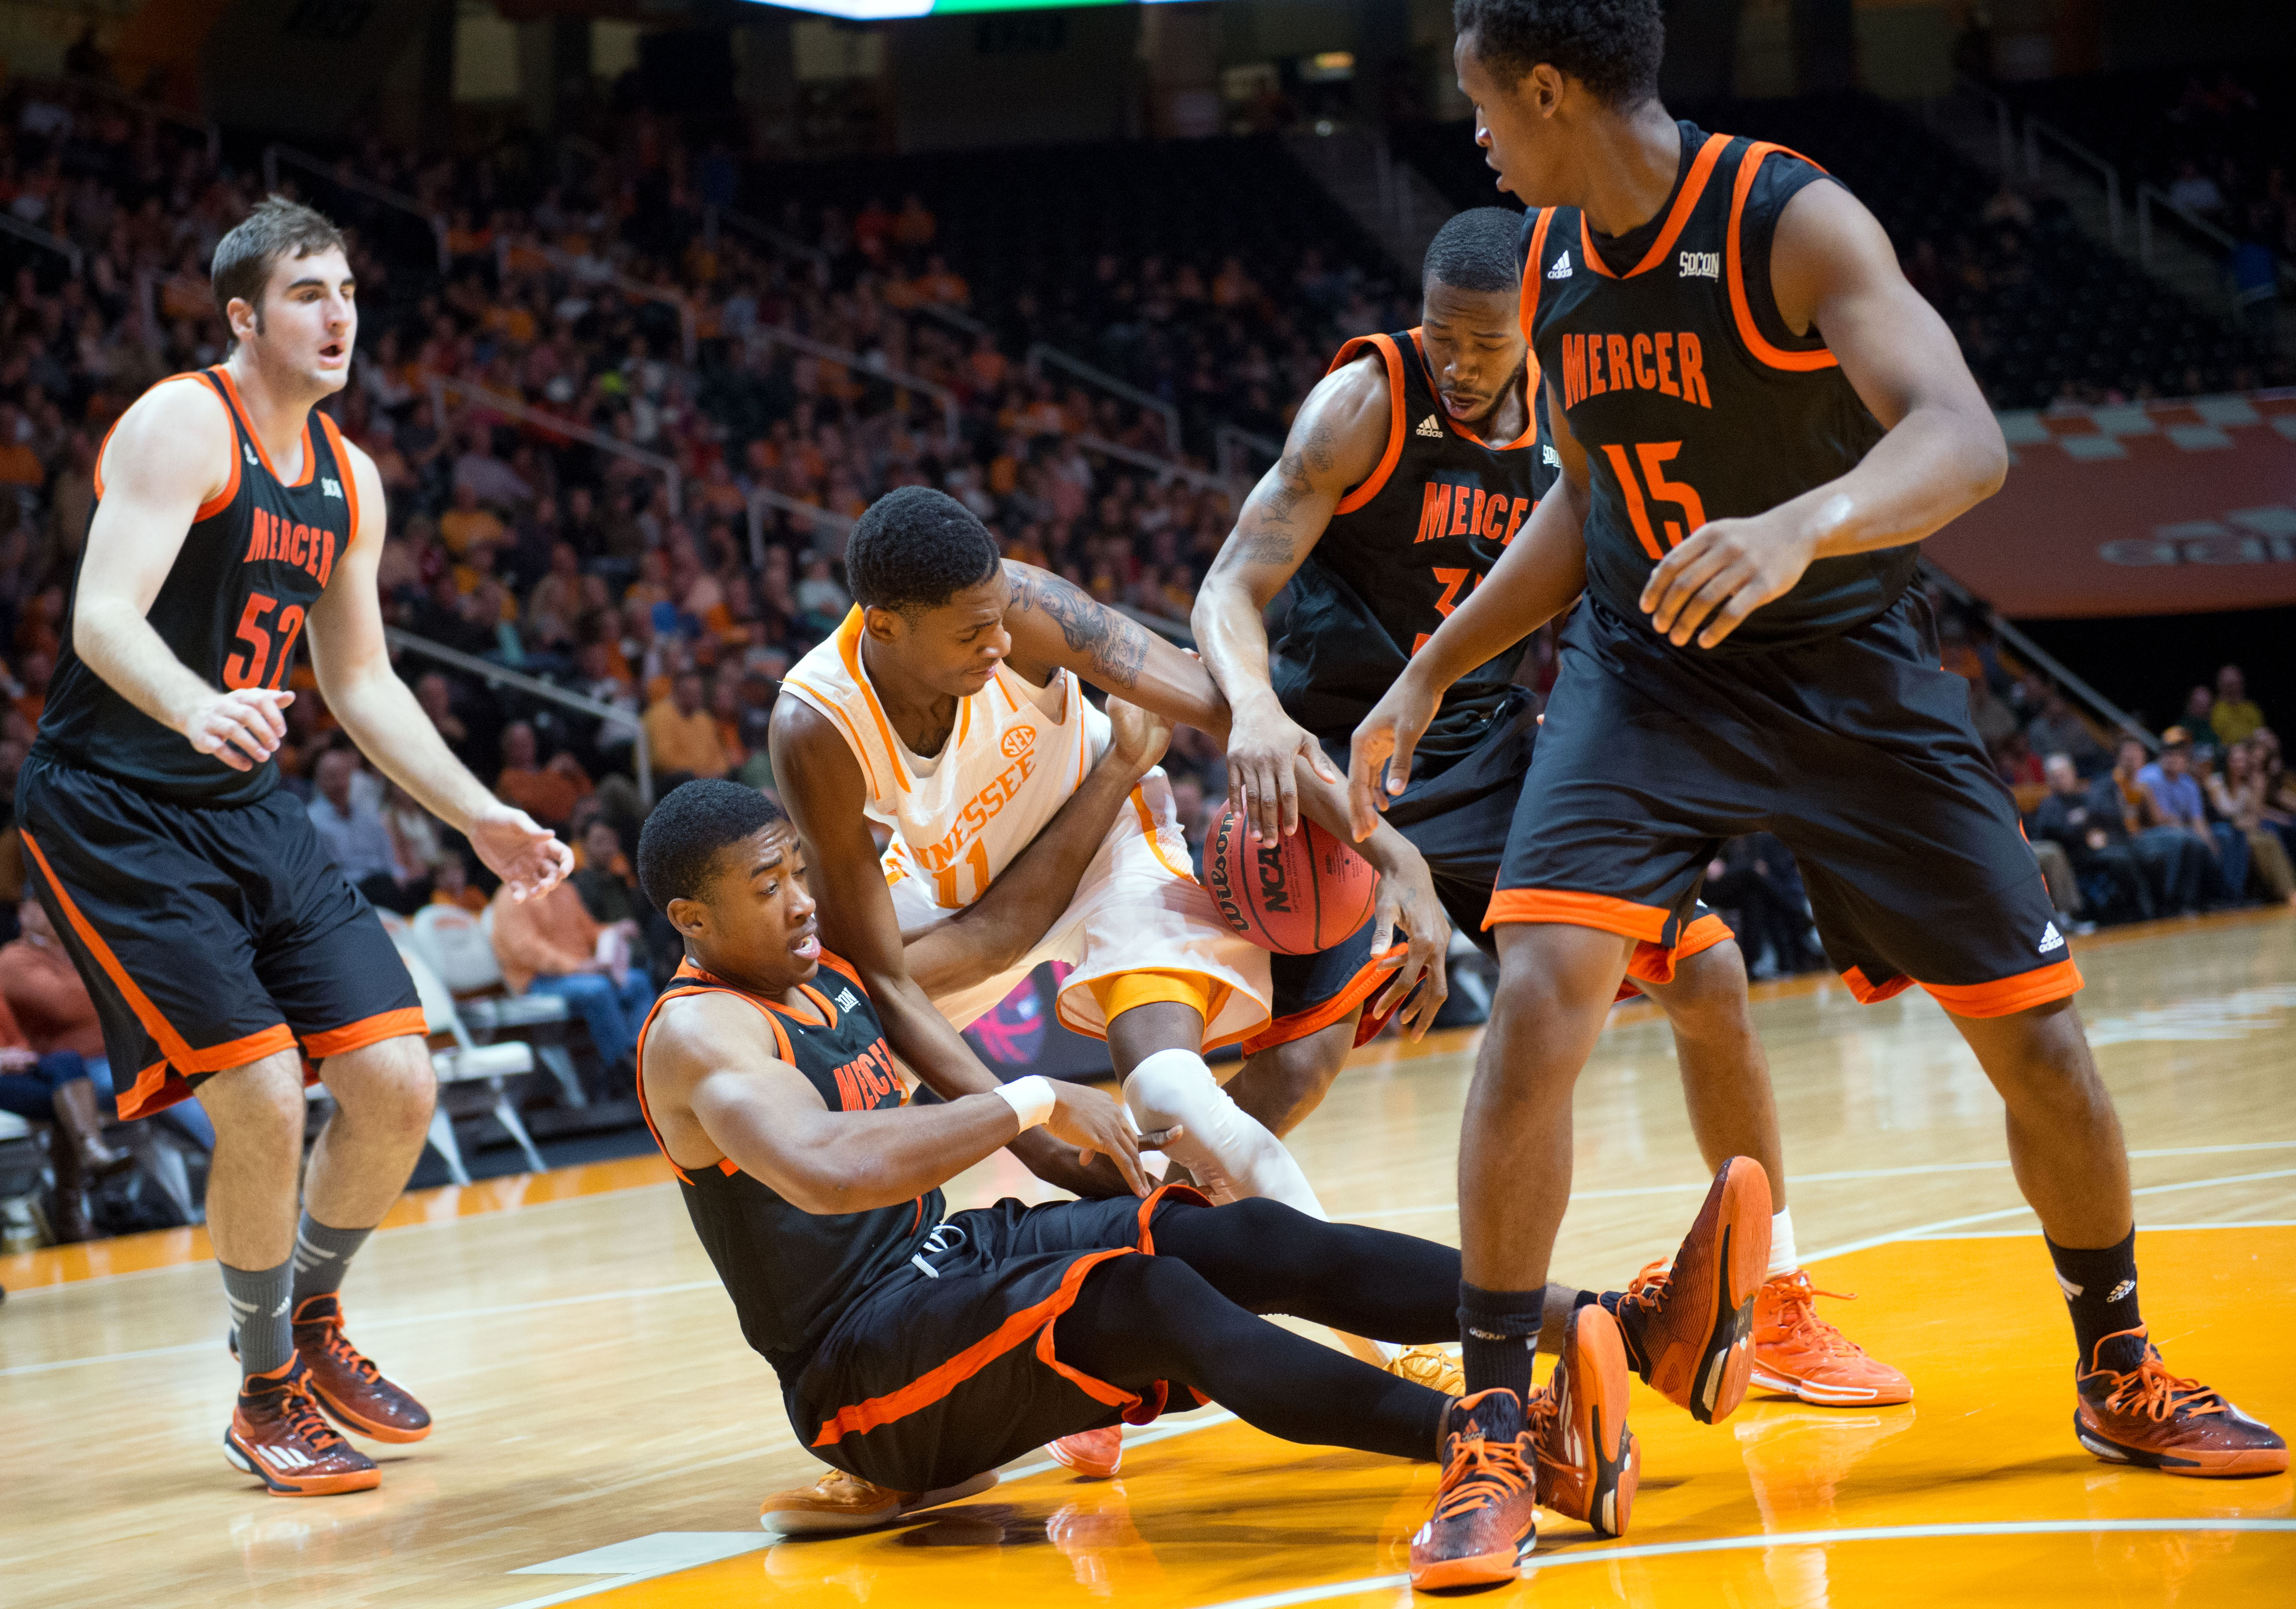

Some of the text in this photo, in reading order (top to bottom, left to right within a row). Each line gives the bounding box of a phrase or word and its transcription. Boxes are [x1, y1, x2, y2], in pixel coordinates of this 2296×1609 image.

[1679, 251, 1720, 280] SOCON
[1562, 332, 1712, 411] MERCER
[1416, 428, 1443, 438] adidas
[1414, 482, 1540, 546] MERCE
[1600, 441, 1706, 560] 15
[243, 507, 335, 589] MERCER
[223, 591, 305, 691] 52
[1003, 727, 1034, 755] SEC
[932, 836, 990, 910] 11
[1211, 812, 1250, 931] Wilson
[1256, 825, 1291, 913] NCA
